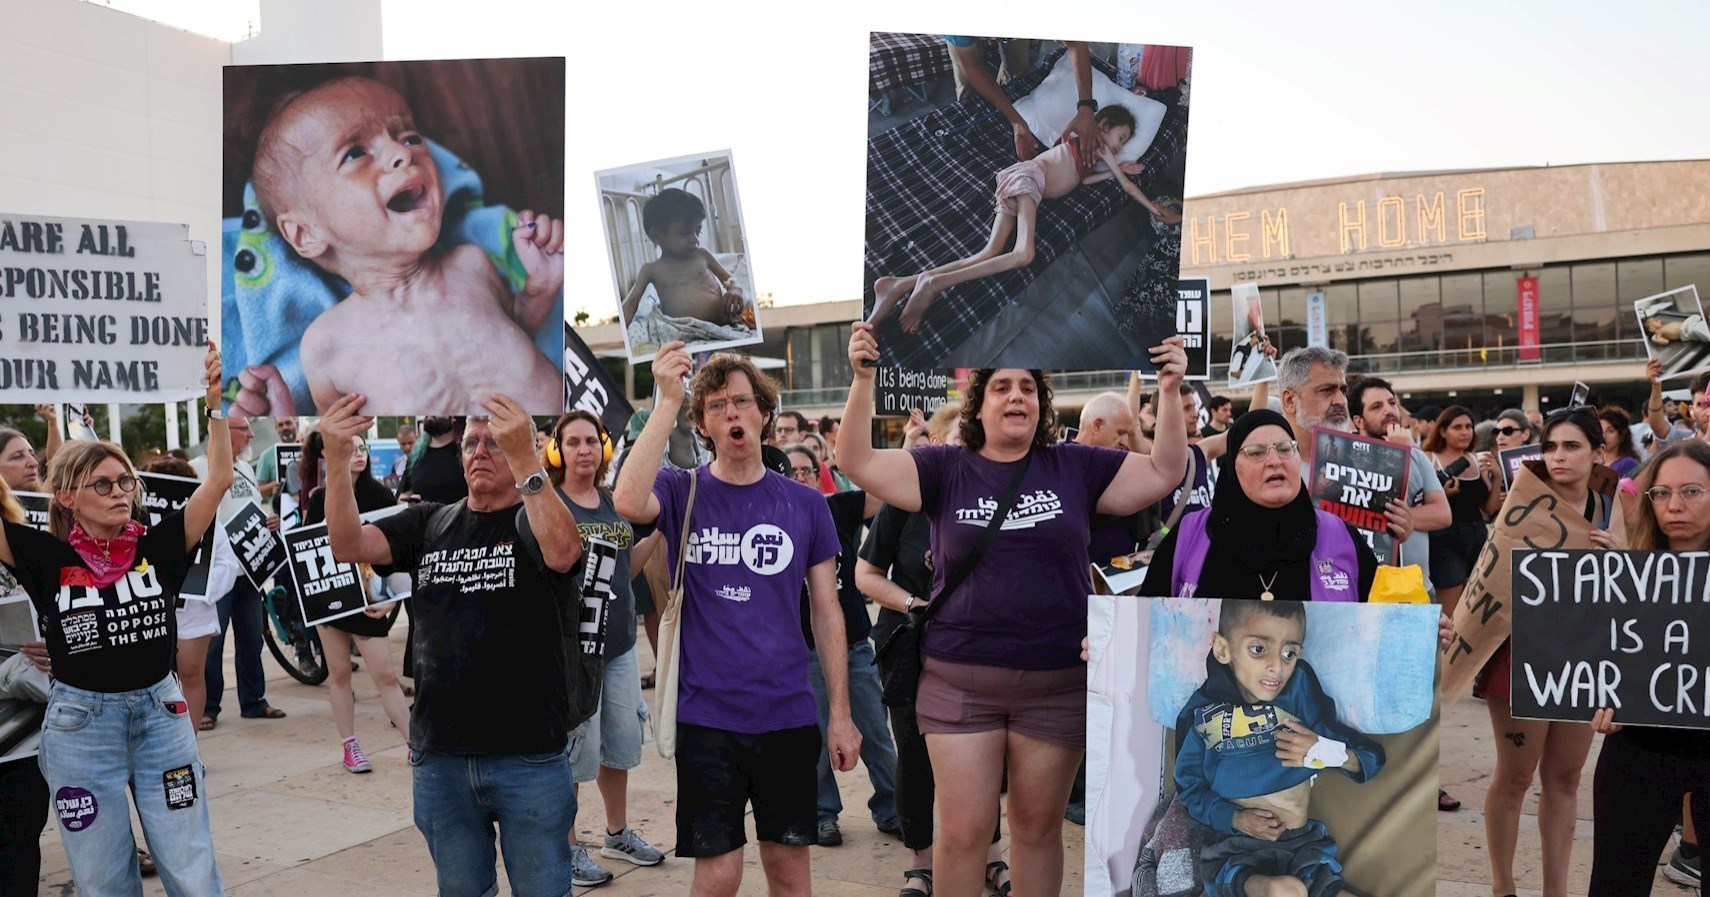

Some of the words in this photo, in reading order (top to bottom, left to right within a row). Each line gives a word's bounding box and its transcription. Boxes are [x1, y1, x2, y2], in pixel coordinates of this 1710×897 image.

[1190, 208, 1289, 265] HEM
[1338, 188, 1487, 254] HOME
[0, 220, 64, 254] ARE
[76, 223, 135, 258] ALL
[1359, 257, 1414, 270] התרבות
[1418, 253, 1453, 265] היכל
[1178, 289, 1202, 299] עומד
[18, 312, 117, 345] BEING
[130, 315, 209, 347] DONE
[0, 357, 59, 390] OUR
[71, 359, 159, 392] NAME
[880, 366, 895, 388] It's
[899, 367, 926, 390] being
[927, 369, 947, 389] done
[884, 391, 896, 411] in
[900, 393, 922, 411] our
[1325, 461, 1393, 492] עוצרים
[1340, 485, 1372, 508] את
[956, 508, 994, 520] ביחד
[293, 540, 314, 551] ביחד
[751, 531, 783, 549] نعم
[685, 543, 740, 565] שלום
[303, 571, 355, 597] ההרעבה
[105, 598, 165, 618] למלחמה
[107, 612, 167, 633] OPPOSE
[108, 632, 138, 646] THE
[142, 625, 168, 640] WAR
[1610, 618, 1644, 654] IS
[1664, 619, 1689, 654] A
[1523, 660, 1622, 708] WAR
[1222, 711, 1233, 737] SPORT
